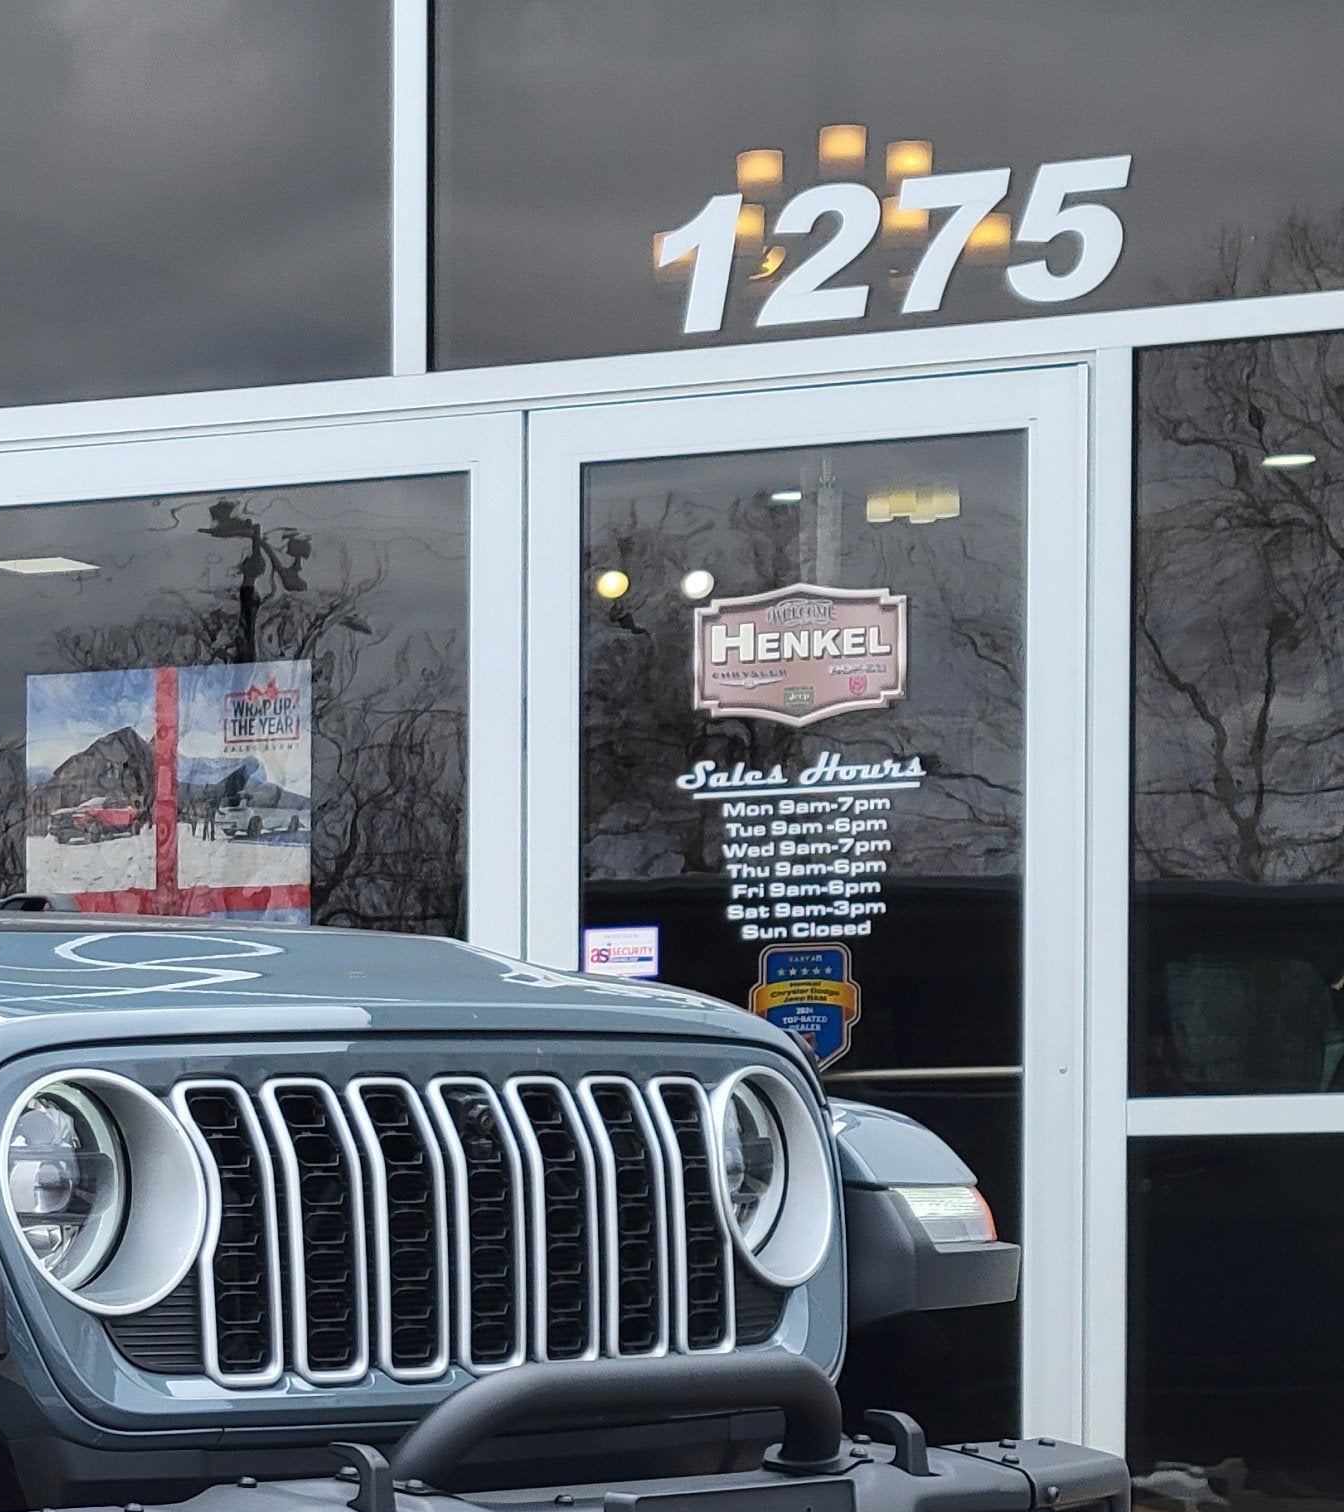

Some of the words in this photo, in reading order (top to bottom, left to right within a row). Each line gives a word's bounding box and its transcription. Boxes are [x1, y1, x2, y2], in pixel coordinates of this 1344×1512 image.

[659, 155, 1132, 335] 1275
[232, 698, 272, 717] WRAP
[273, 697, 292, 715] UP
[231, 718, 256, 736] THE
[259, 717, 293, 735] YEAR
[675, 759, 788, 790] Sales
[798, 751, 927, 783] Hours
[722, 802, 774, 818] Mon
[778, 796, 891, 817] 9am-7pm
[726, 823, 767, 838] Tue
[722, 842, 775, 859] Wed
[779, 838, 892, 858] 9am-7pm
[726, 863, 770, 879] Thu
[774, 859, 888, 878] 9am-6pm
[731, 884, 765, 899] Fri
[769, 879, 882, 898] 9am-6pm
[726, 904, 770, 920] Sat
[774, 900, 887, 919] 9am-3pm
[742, 924, 788, 941] Sun
[791, 920, 872, 938] Closed
[612, 946, 653, 956] SECURITY
